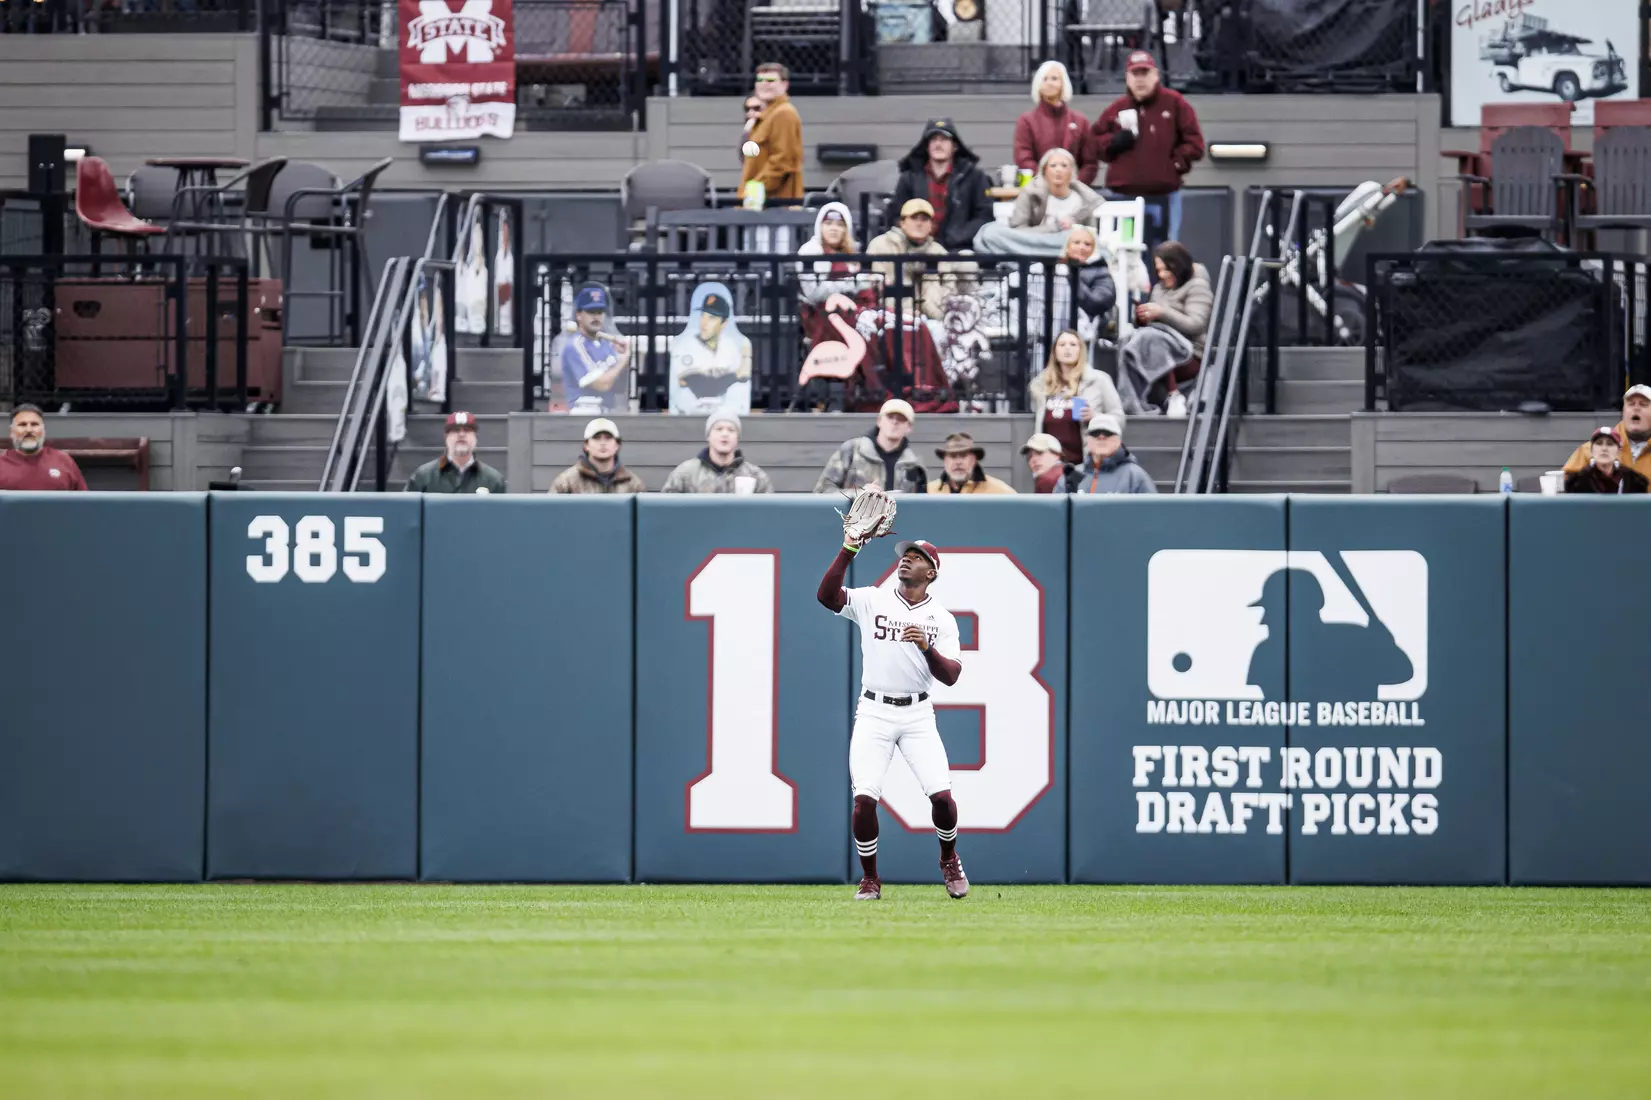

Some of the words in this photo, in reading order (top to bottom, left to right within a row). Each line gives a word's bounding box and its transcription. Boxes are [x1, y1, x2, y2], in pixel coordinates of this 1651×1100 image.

[423, 18, 489, 40] STATE
[246, 515, 387, 583] 385
[873, 614, 938, 648] STE
[1147, 700, 1220, 725] MAJOR
[1226, 701, 1311, 726] LEAGUE
[1317, 702, 1425, 726] BASEBALL
[1132, 745, 1271, 787] FIRST
[1280, 747, 1443, 789] ROUND
[1135, 791, 1293, 834] DRAFT
[1301, 793, 1439, 835] PICKS
